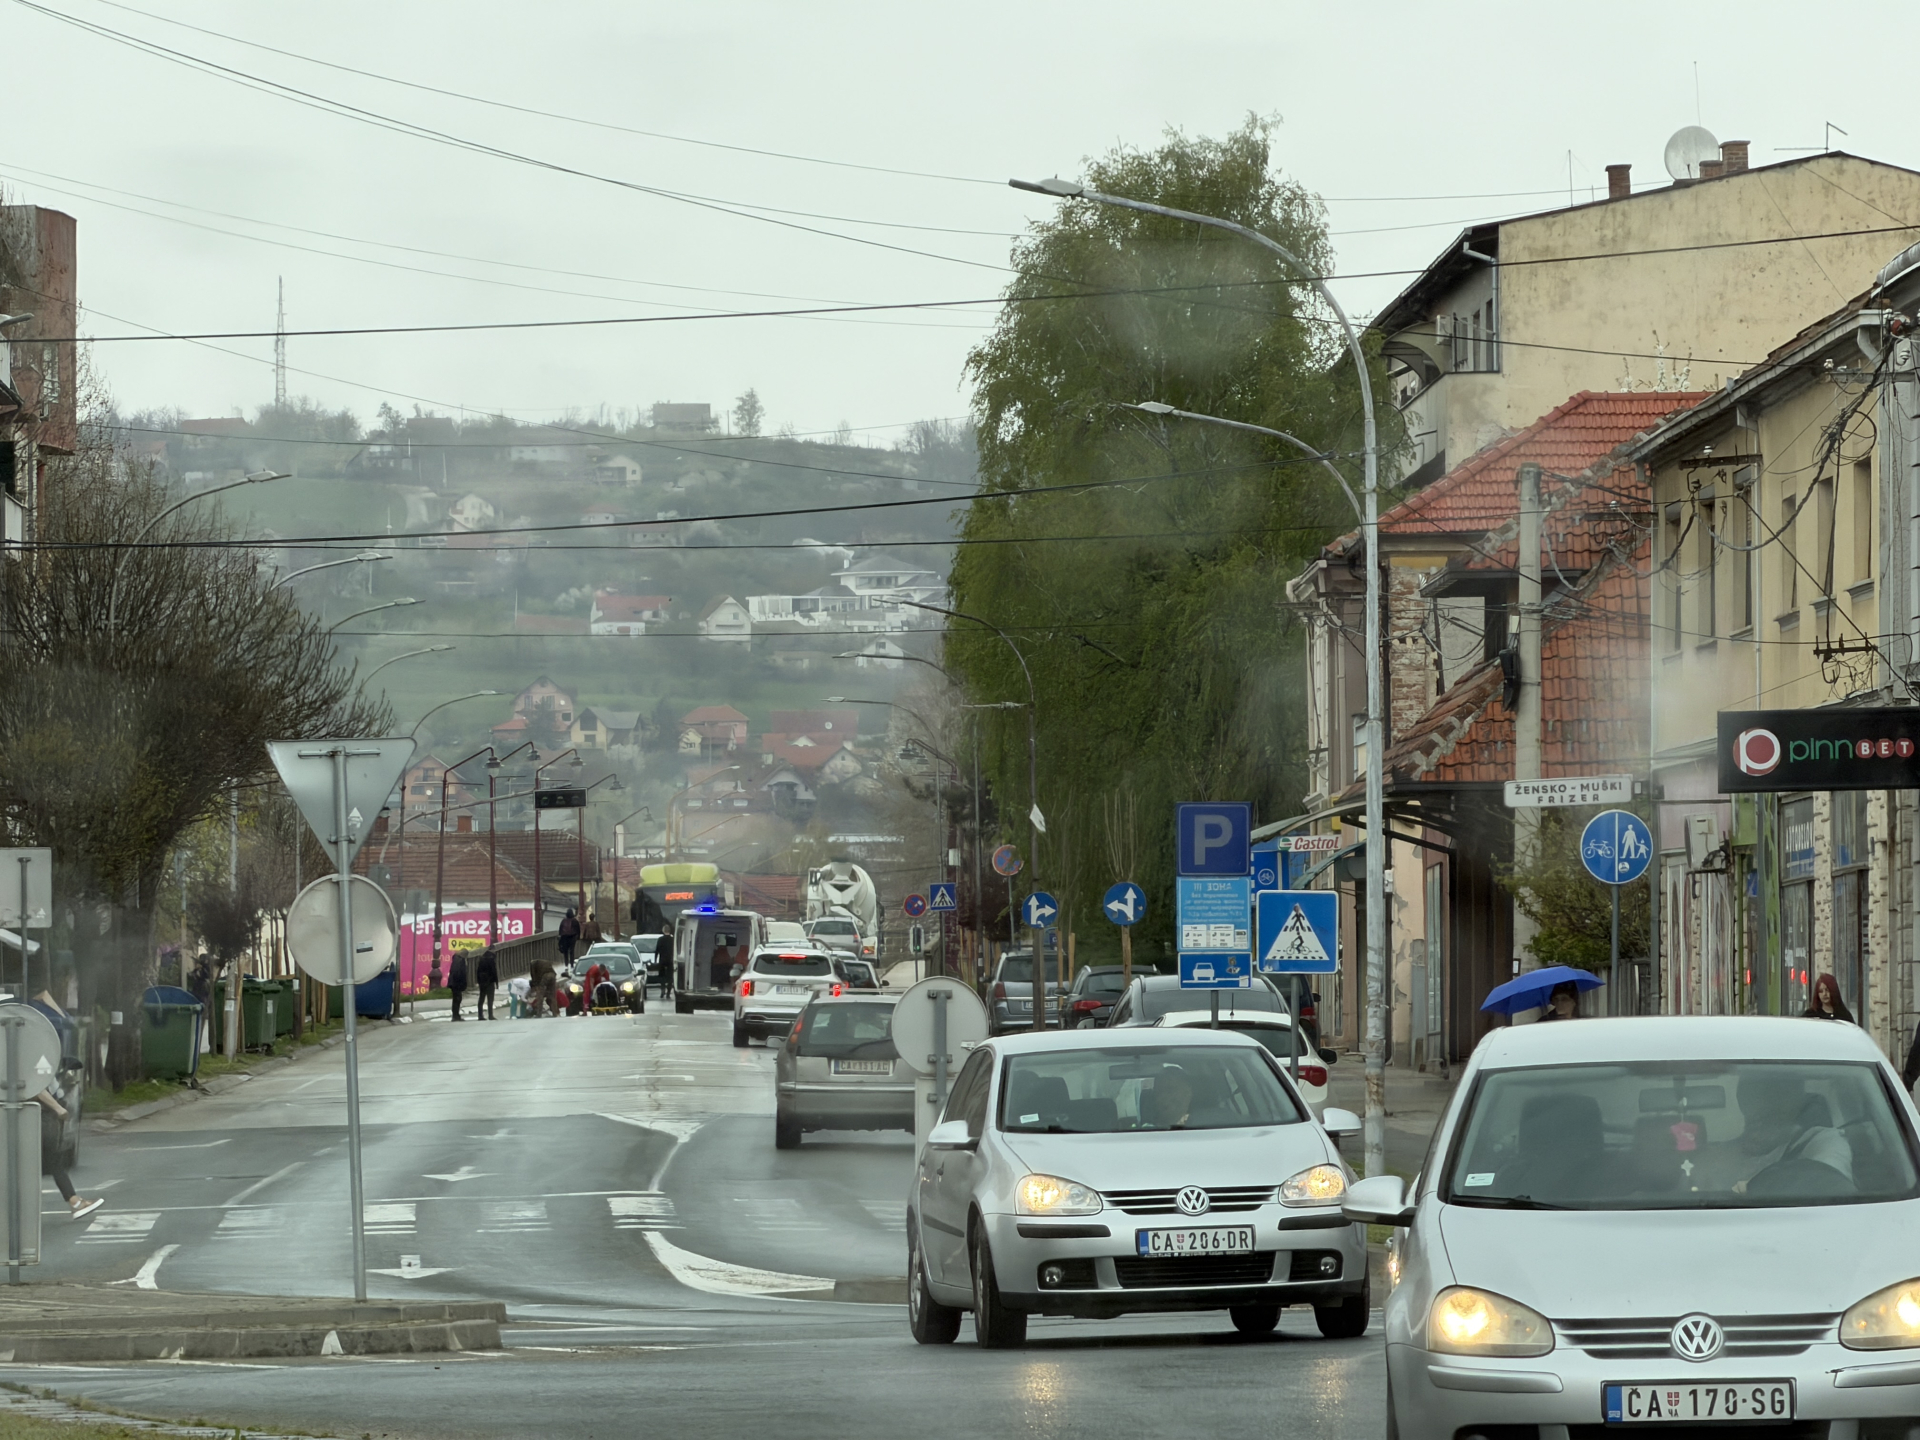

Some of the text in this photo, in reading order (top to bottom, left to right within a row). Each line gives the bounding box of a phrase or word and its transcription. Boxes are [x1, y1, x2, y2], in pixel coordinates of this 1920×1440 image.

[1514, 784, 1567, 796] ŽENSKO
[1580, 780, 1622, 793] MUŠKI
[1537, 793, 1600, 804] FRIZER
[1194, 814, 1233, 866] P
[1294, 836, 1339, 850] Castrol
[1151, 1232, 1174, 1251] ČA
[1627, 1387, 1663, 1418] ČA
